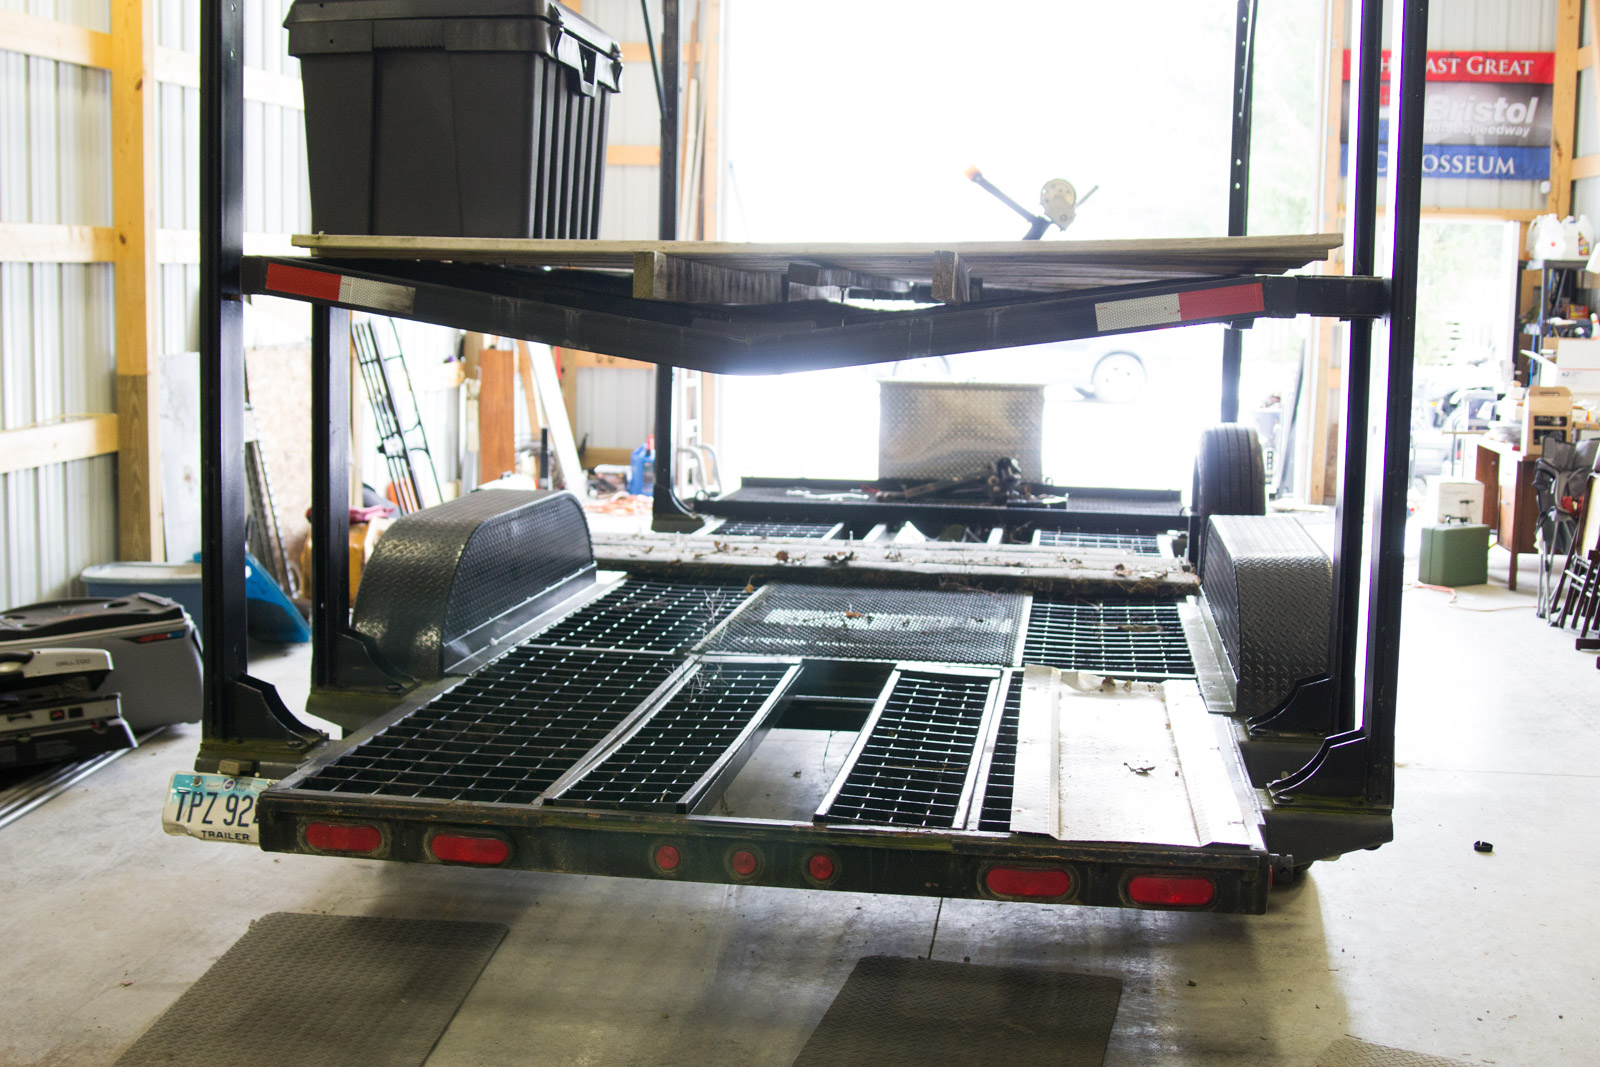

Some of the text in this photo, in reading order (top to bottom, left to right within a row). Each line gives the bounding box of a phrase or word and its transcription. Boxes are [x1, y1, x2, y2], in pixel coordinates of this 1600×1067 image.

[1426, 56, 1535, 75] AST GREAT
[1427, 94, 1539, 124] Bristol
[1463, 123, 1530, 138] Speedway
[176, 790, 218, 825] TPZ
[201, 830, 250, 841] TRAILER
